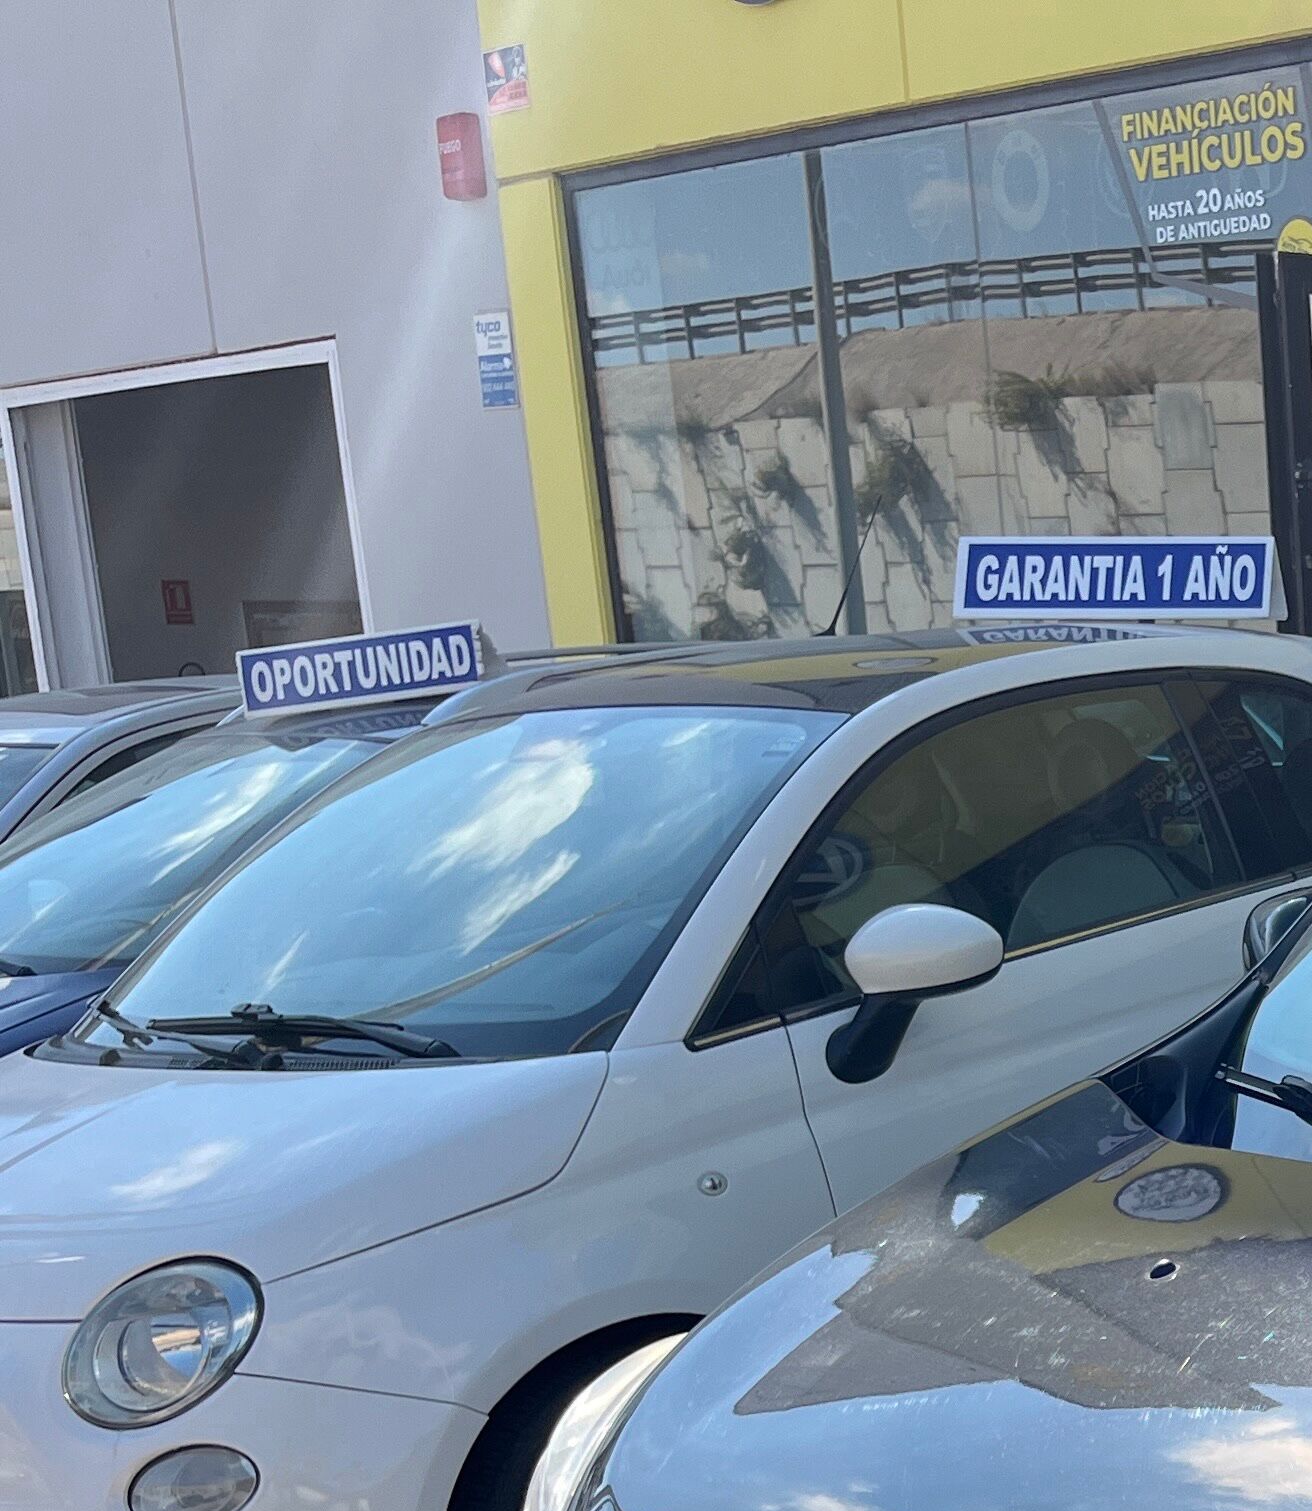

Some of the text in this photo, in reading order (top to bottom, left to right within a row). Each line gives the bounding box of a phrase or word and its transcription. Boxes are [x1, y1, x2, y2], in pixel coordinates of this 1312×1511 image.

[1120, 82, 1296, 143] FINANCIACIÓN
[1129, 122, 1305, 182] VEHÍCULOS
[1148, 187, 1265, 222] HASTA 20 AÑOS
[1156, 213, 1271, 244] DE ANTIGUEDAD
[475, 320, 501, 336] tyco
[975, 544, 1256, 602] GARANTIA 1 AÑO
[251, 633, 471, 703] OPORTUNIDAD
